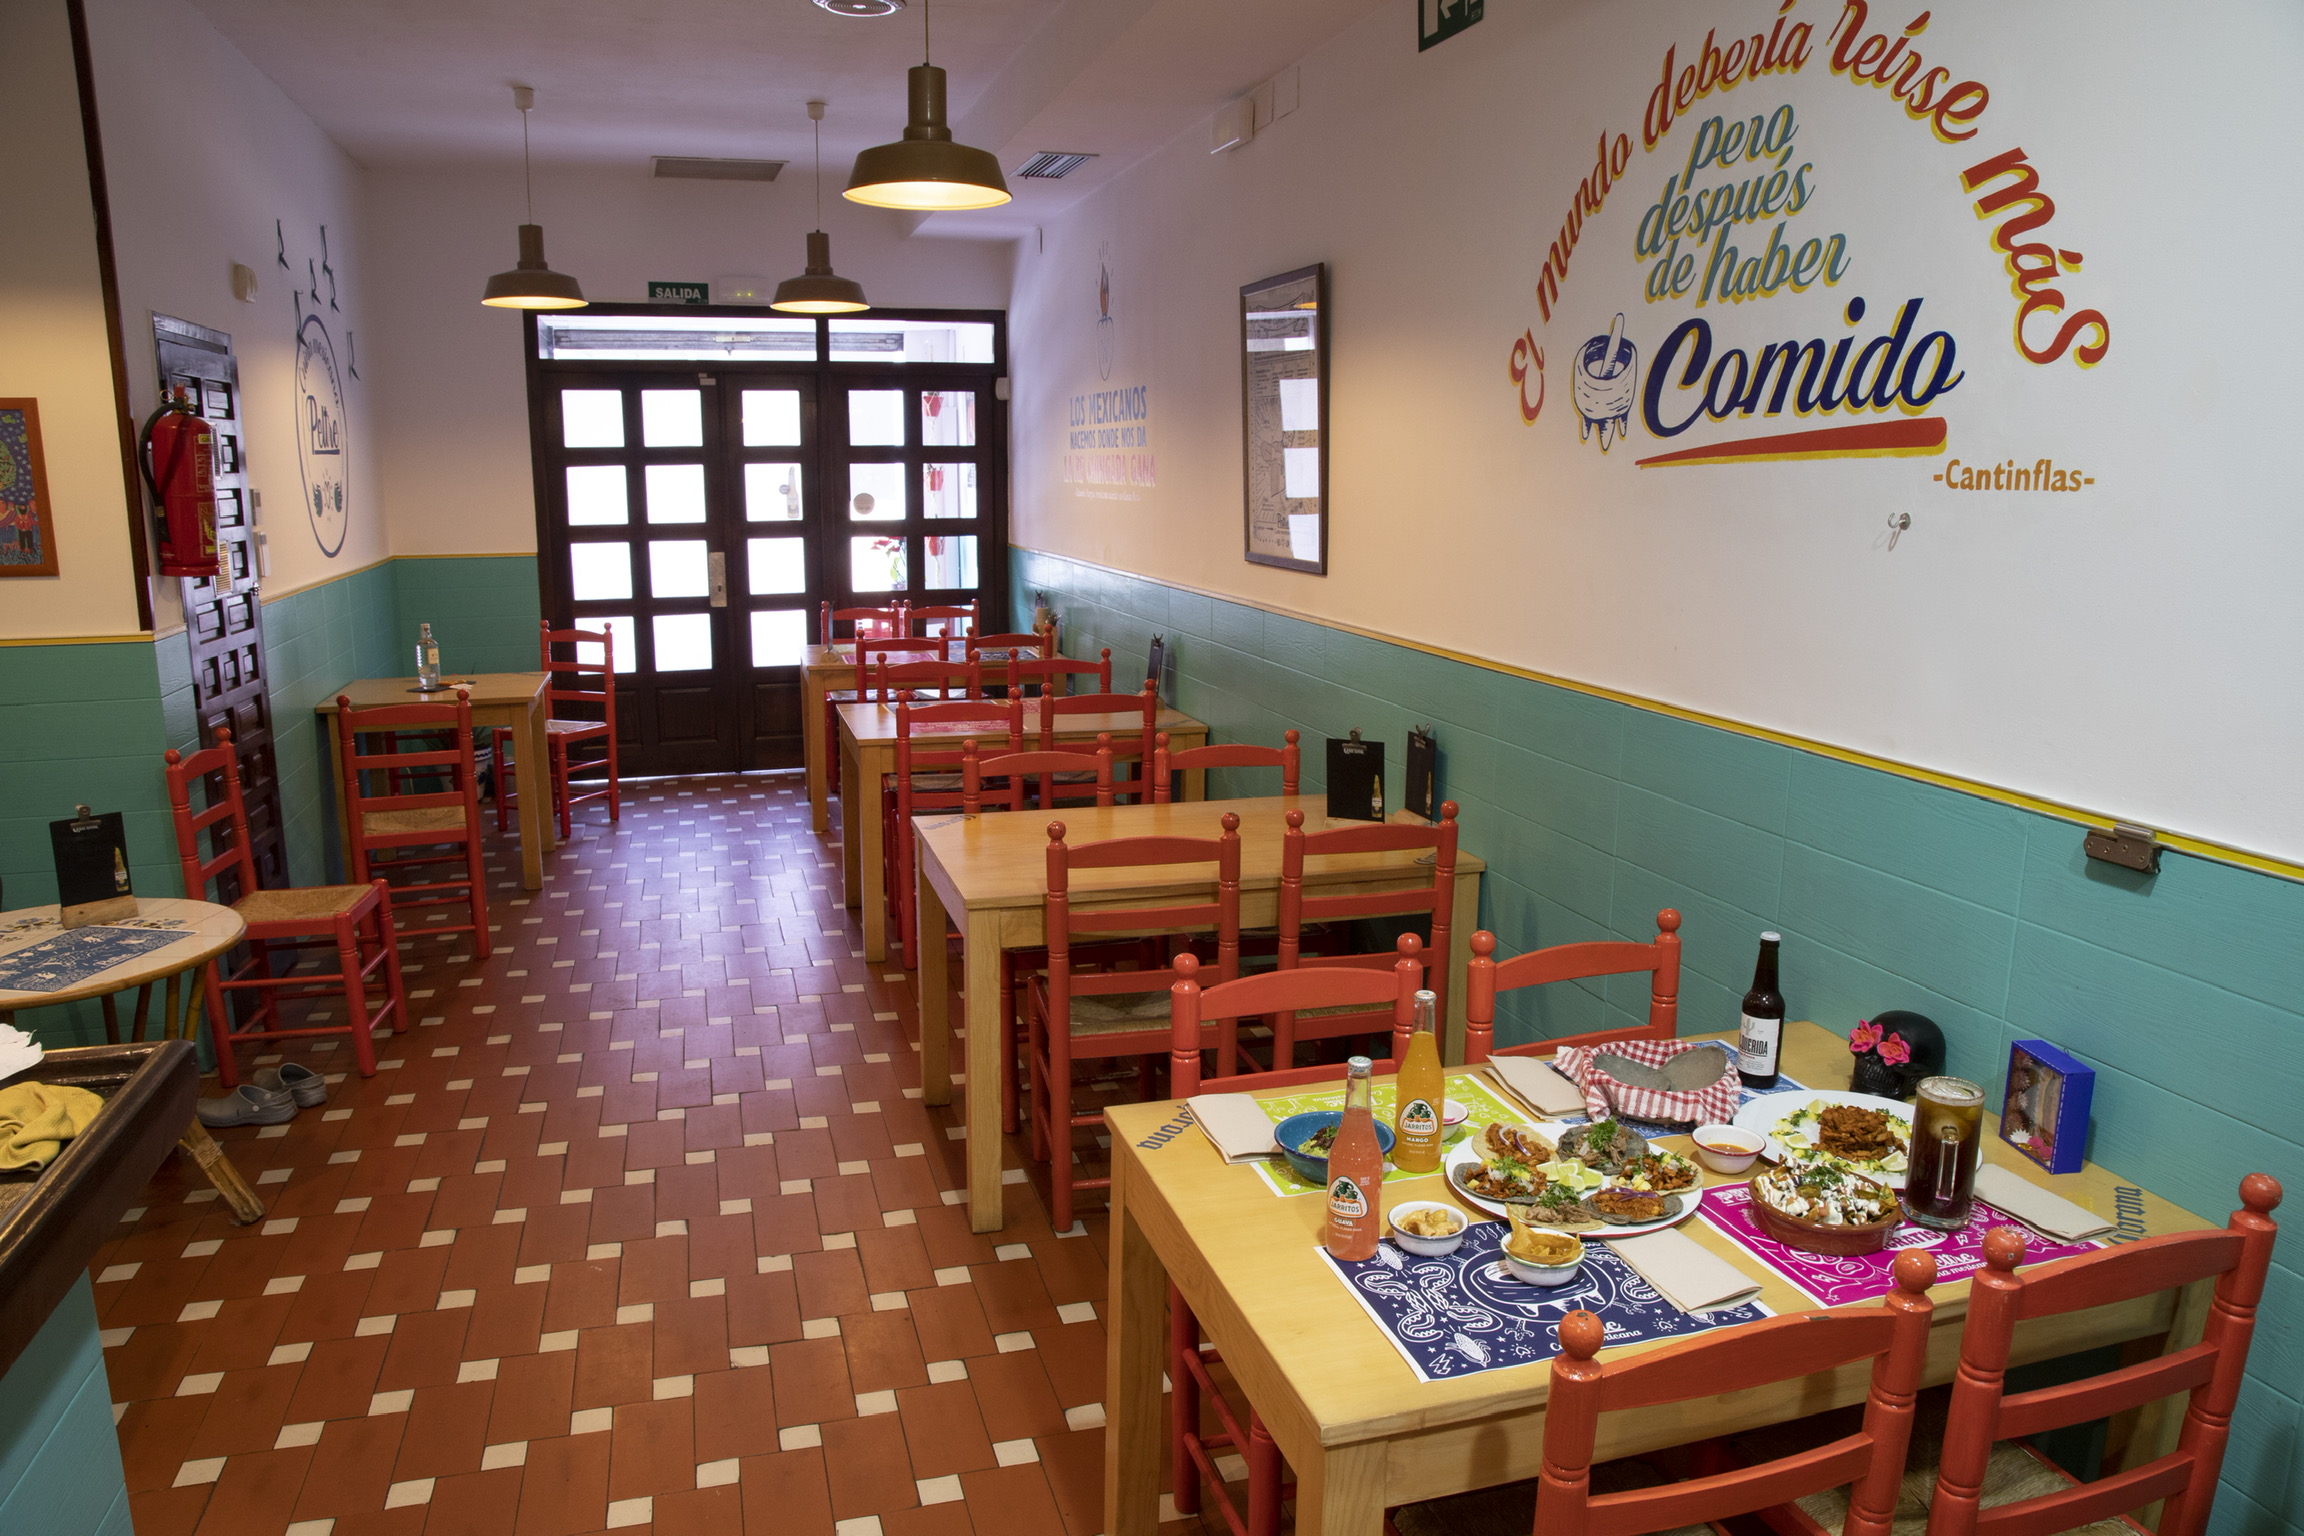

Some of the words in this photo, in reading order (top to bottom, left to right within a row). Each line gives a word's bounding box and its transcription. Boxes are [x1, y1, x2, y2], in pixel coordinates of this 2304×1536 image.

[1679, 103, 1800, 195] pero
[1509, 328, 1545, 424] El
[1537, 128, 1634, 323] mundo
[1642, 0, 1814, 152] debería
[1960, 146, 2110, 369] más
[1635, 145, 1816, 263] después
[1645, 237, 1697, 304] de
[1696, 221, 1852, 308] haber
[655, 287, 702, 299] SALIDA
[1641, 297, 1966, 439] Comido
[1070, 395, 1085, 426] LOS
[1088, 385, 1147, 424] MEXICANOS
[1070, 430, 1096, 449] NACEMOS
[1098, 428, 1119, 448] DONDE
[1121, 427, 1134, 448] NOS
[1138, 426, 1147, 447] DA
[1933, 458, 2096, 492] -Cantinflas-
[1404, 1122, 1432, 1131] JARRITOS
[1330, 1201, 1360, 1213] JARRITOS
[1333, 1217, 1354, 1227] GUAVA
